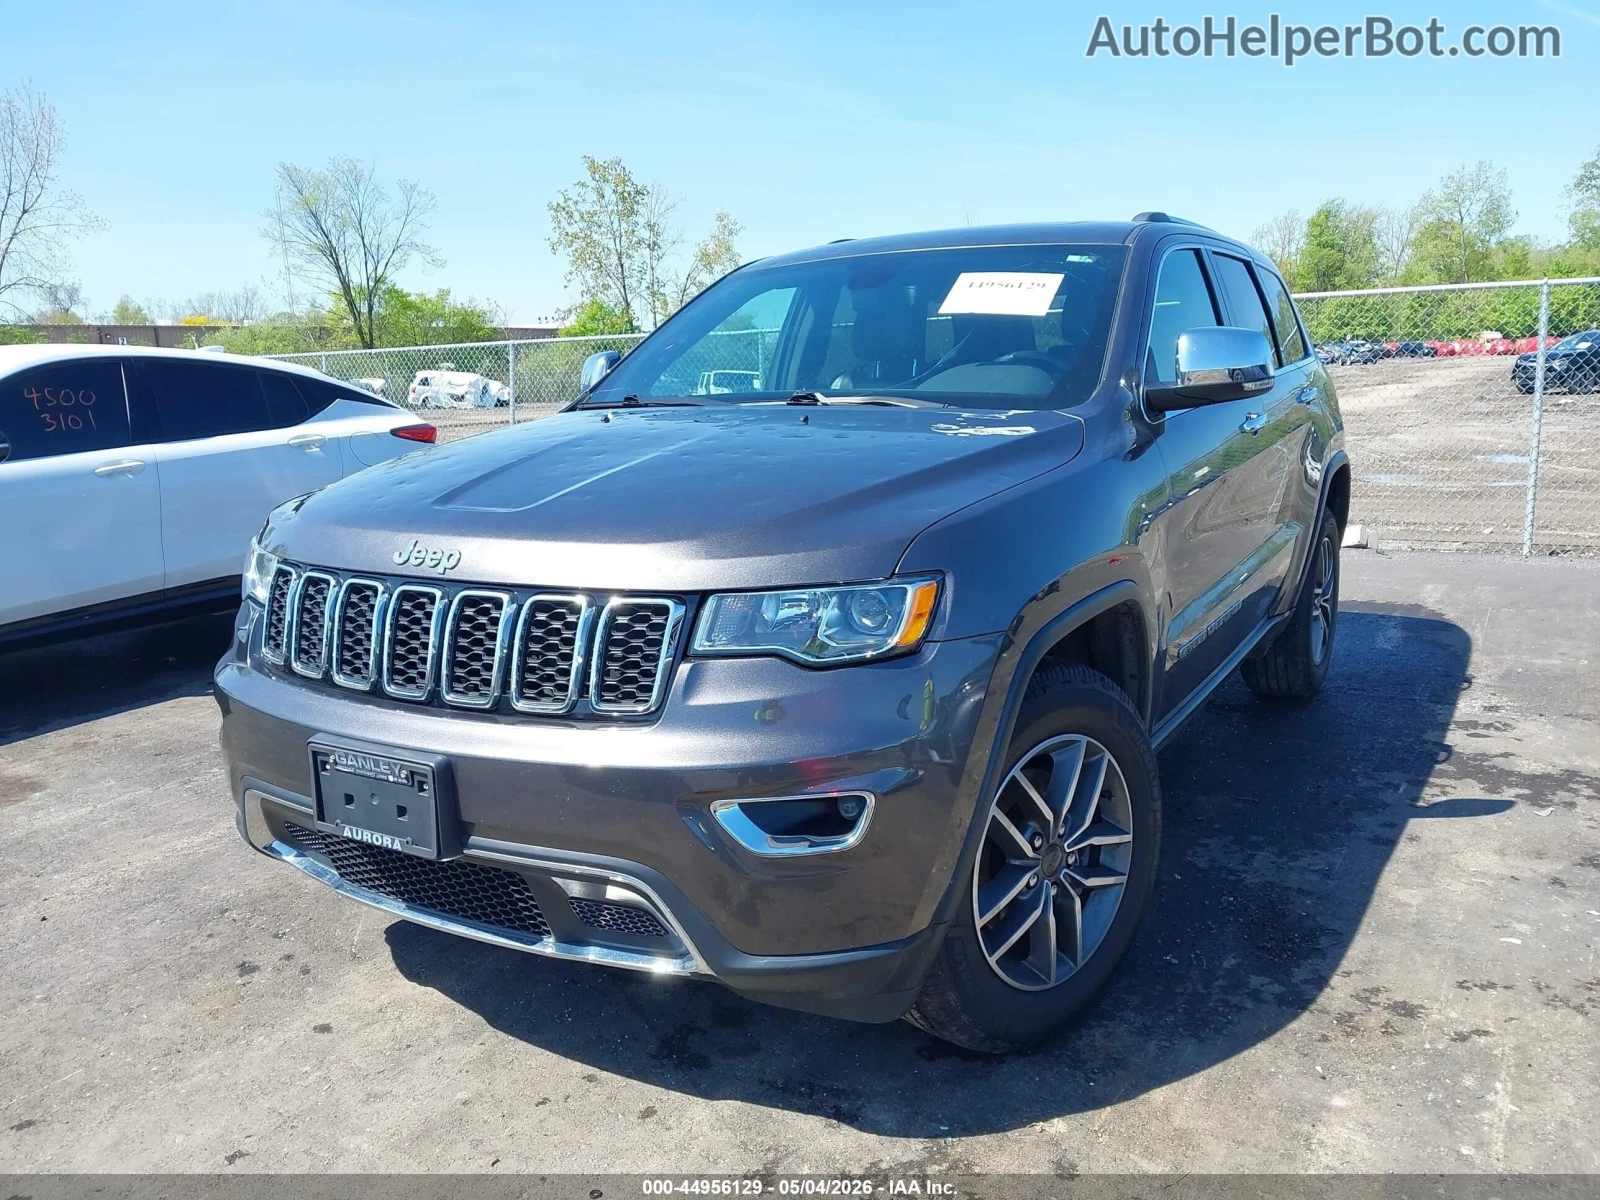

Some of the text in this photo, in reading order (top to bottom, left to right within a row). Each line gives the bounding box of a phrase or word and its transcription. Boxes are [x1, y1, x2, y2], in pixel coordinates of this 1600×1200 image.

[23, 386, 96, 410] 4500
[40, 409, 98, 432] 3101
[392, 539, 462, 576] Jeep
[335, 751, 403, 776] GANLEY
[343, 826, 403, 851] AURORA
